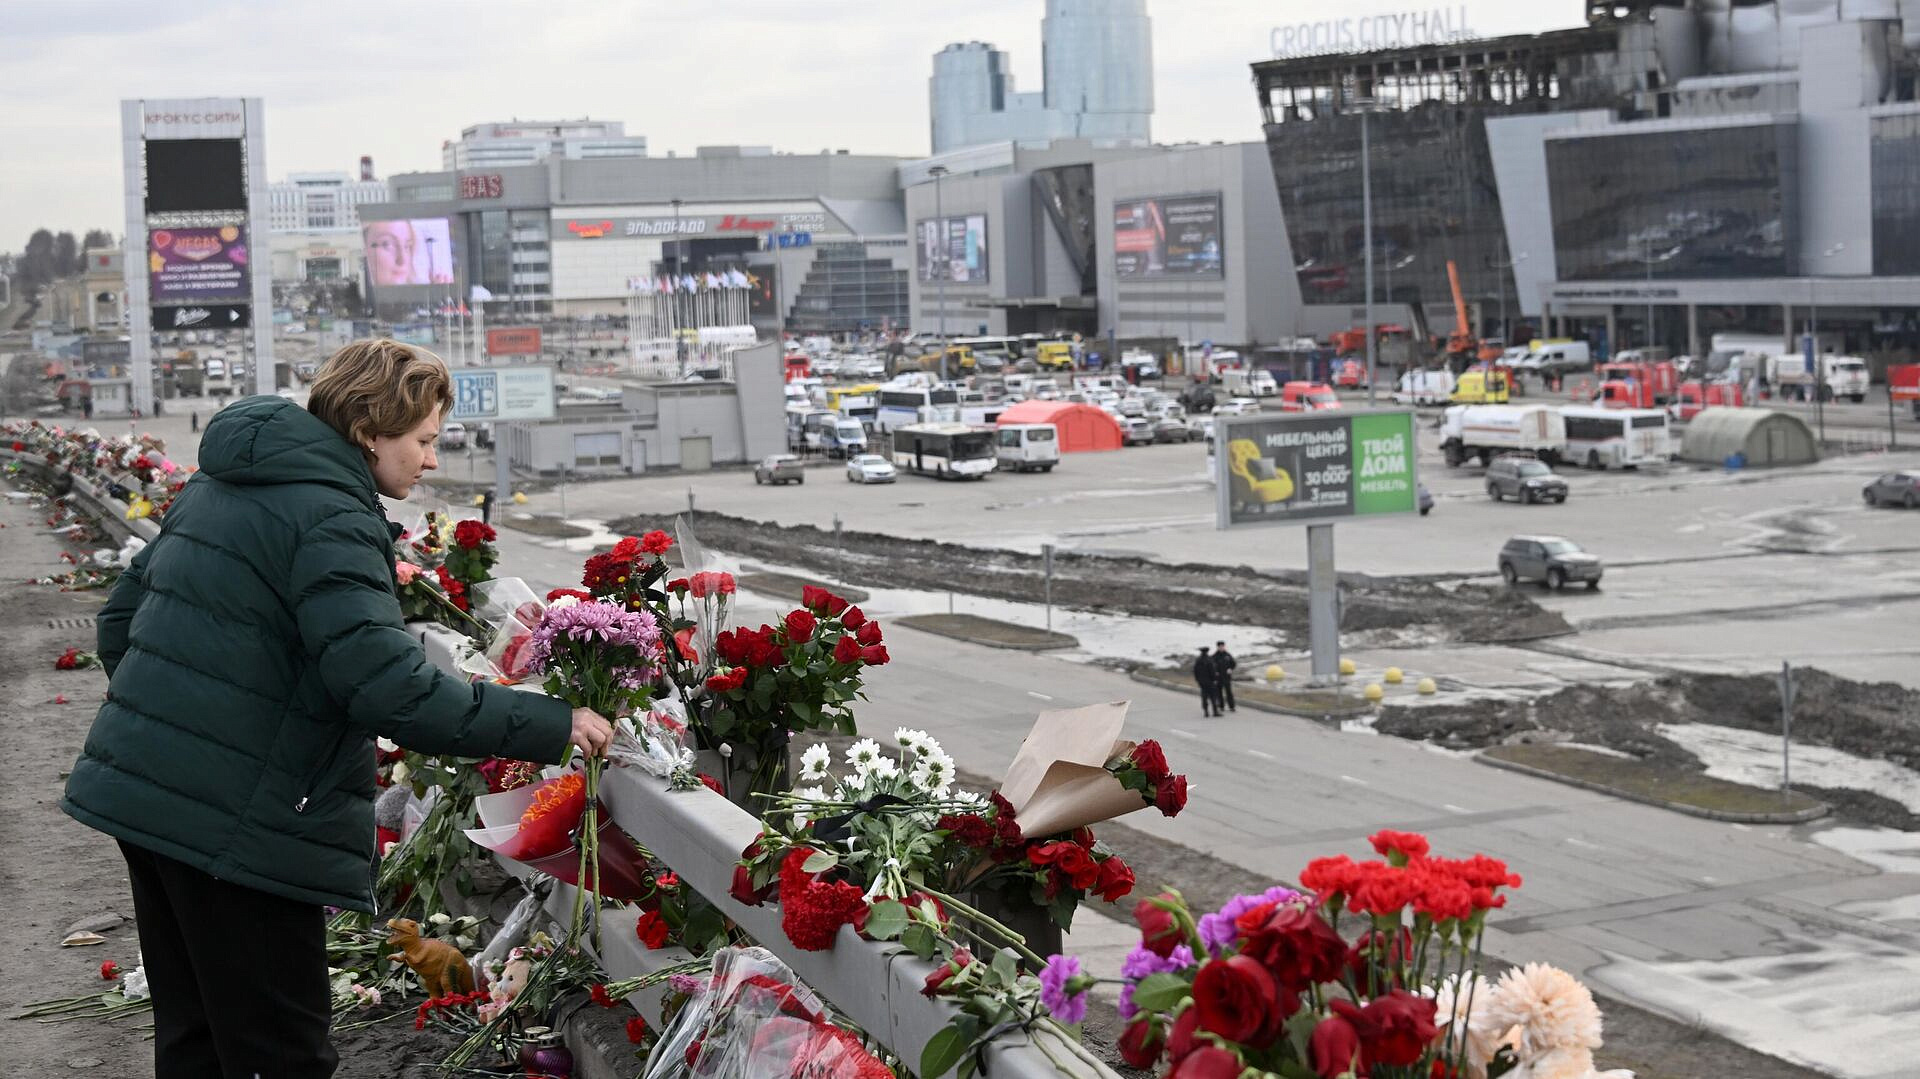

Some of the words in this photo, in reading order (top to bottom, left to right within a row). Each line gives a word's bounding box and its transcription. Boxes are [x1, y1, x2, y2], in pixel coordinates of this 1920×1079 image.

[1270, 18, 1354, 54] CROCUS
[1360, 13, 1407, 49] CITY
[1412, 5, 1474, 46] HALL
[144, 112, 201, 124] КРОКУС
[205, 112, 240, 124] СИТИ
[626, 219, 705, 236] ЭЛЬДОРАДО
[1266, 427, 1347, 447] МЕБЕЛЬНЫЙ
[1361, 433, 1404, 455] ТВОЙ
[1306, 444, 1347, 458] ЦЕНТР
[1360, 455, 1406, 477] ДОМ
[1360, 480, 1408, 492] МЕБЕЛЬ
